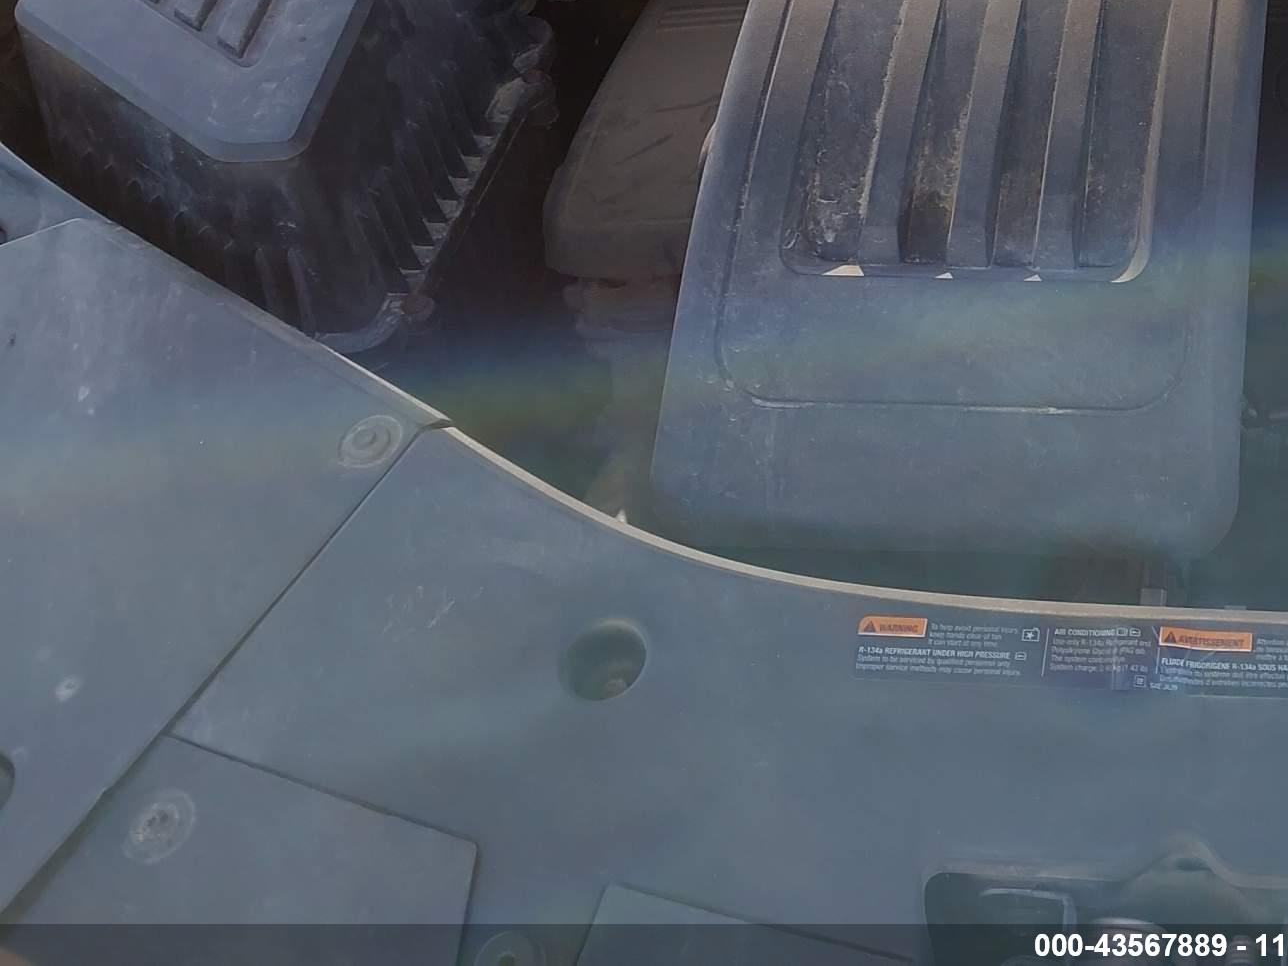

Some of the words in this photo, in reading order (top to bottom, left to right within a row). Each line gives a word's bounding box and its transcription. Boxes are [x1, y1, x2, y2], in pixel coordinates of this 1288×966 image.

[1067, 628, 1116, 637] CONDITIONING
[858, 645, 882, 654] R-134a
[884, 646, 931, 656] REFRIGERANT
[932, 648, 955, 657] UNDER
[957, 650, 974, 658] HIGH
[975, 650, 1011, 660] PRESSURE
[1257, 663, 1275, 671] SOUS
